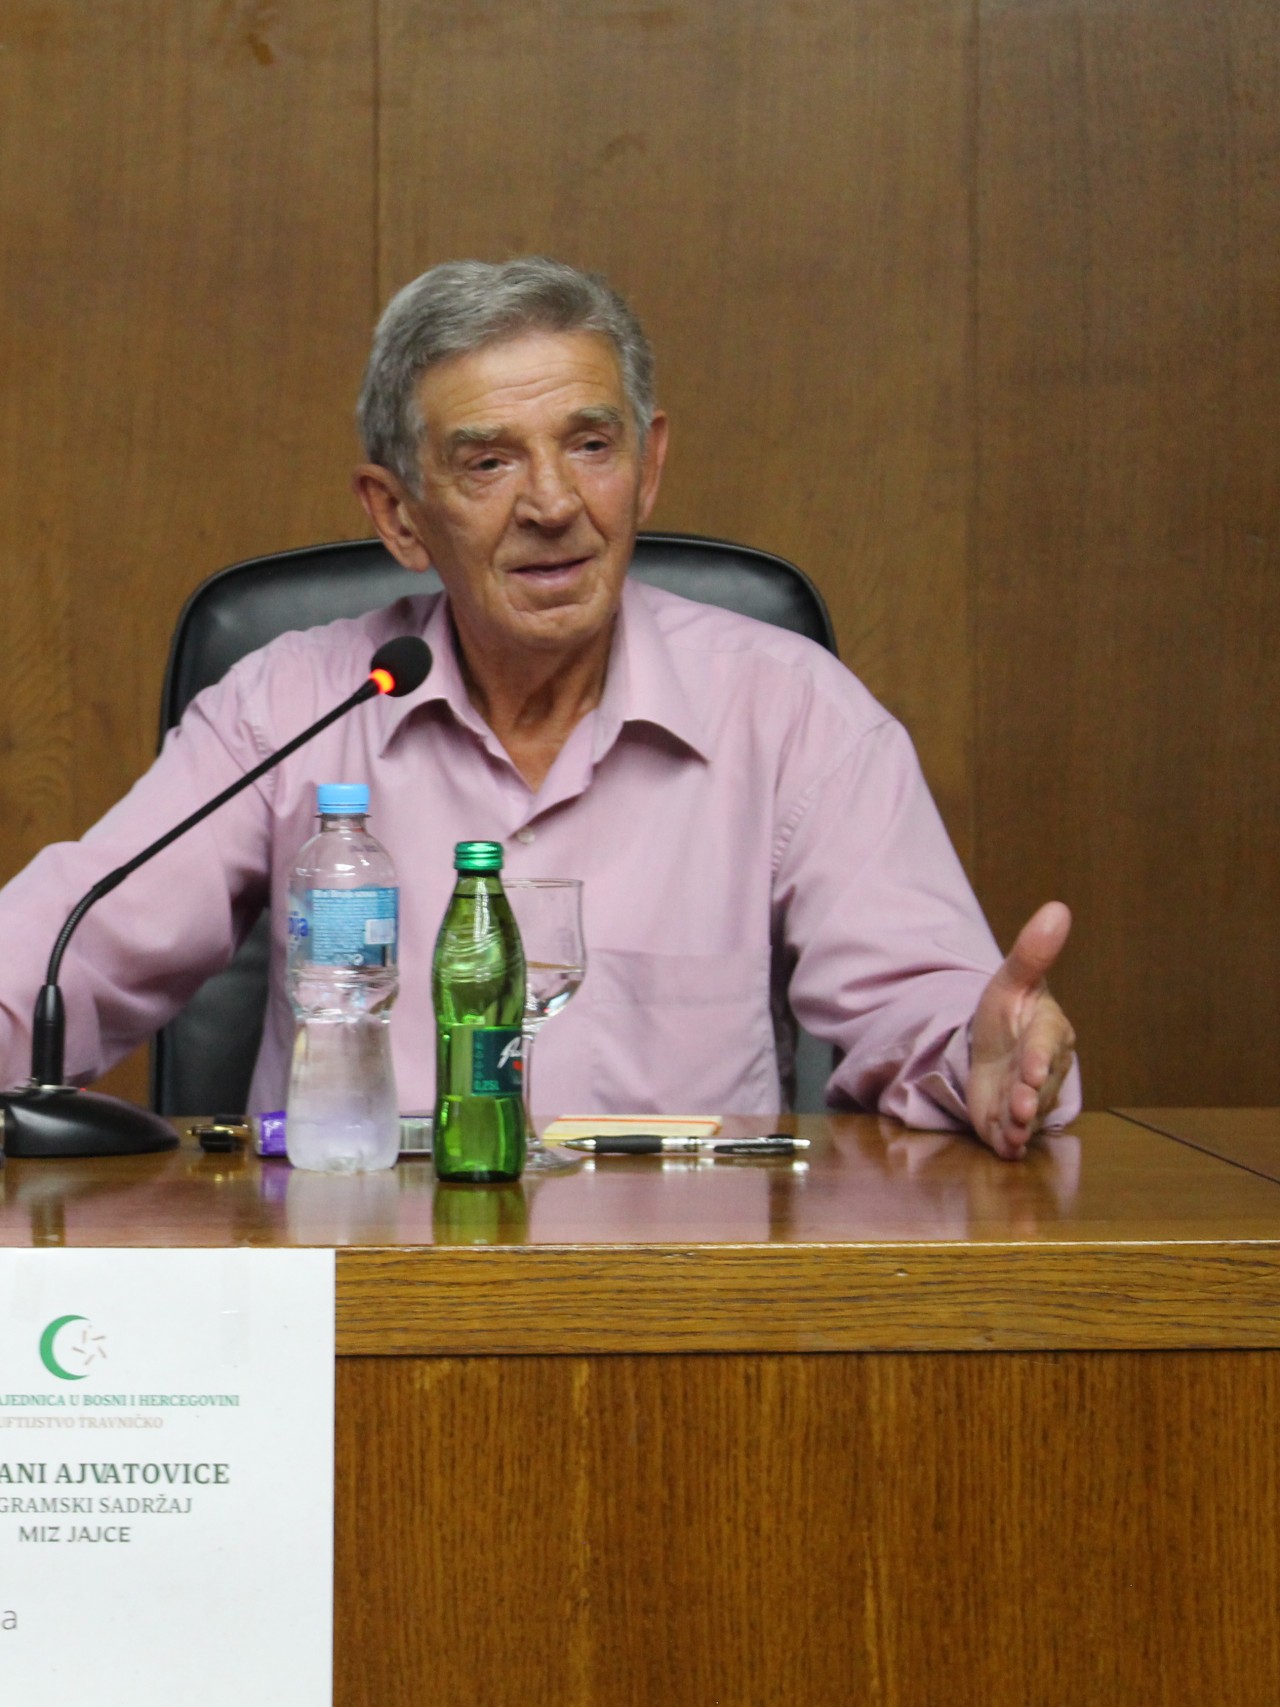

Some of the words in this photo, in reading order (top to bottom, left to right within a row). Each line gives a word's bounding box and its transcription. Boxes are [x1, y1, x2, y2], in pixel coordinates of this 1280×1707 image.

[69, 1394, 80, 1406] U
[83, 1395, 126, 1406] BOSNI
[130, 1395, 135, 1406] I
[139, 1395, 240, 1406] HERCEGOVINI
[79, 1414, 164, 1428] TRAVNIČKO
[54, 1463, 230, 1484] AJVATOVICE
[99, 1494, 192, 1514] SADRŽAJ
[19, 1526, 60, 1542] MIZ
[67, 1526, 131, 1543] JAJCE
